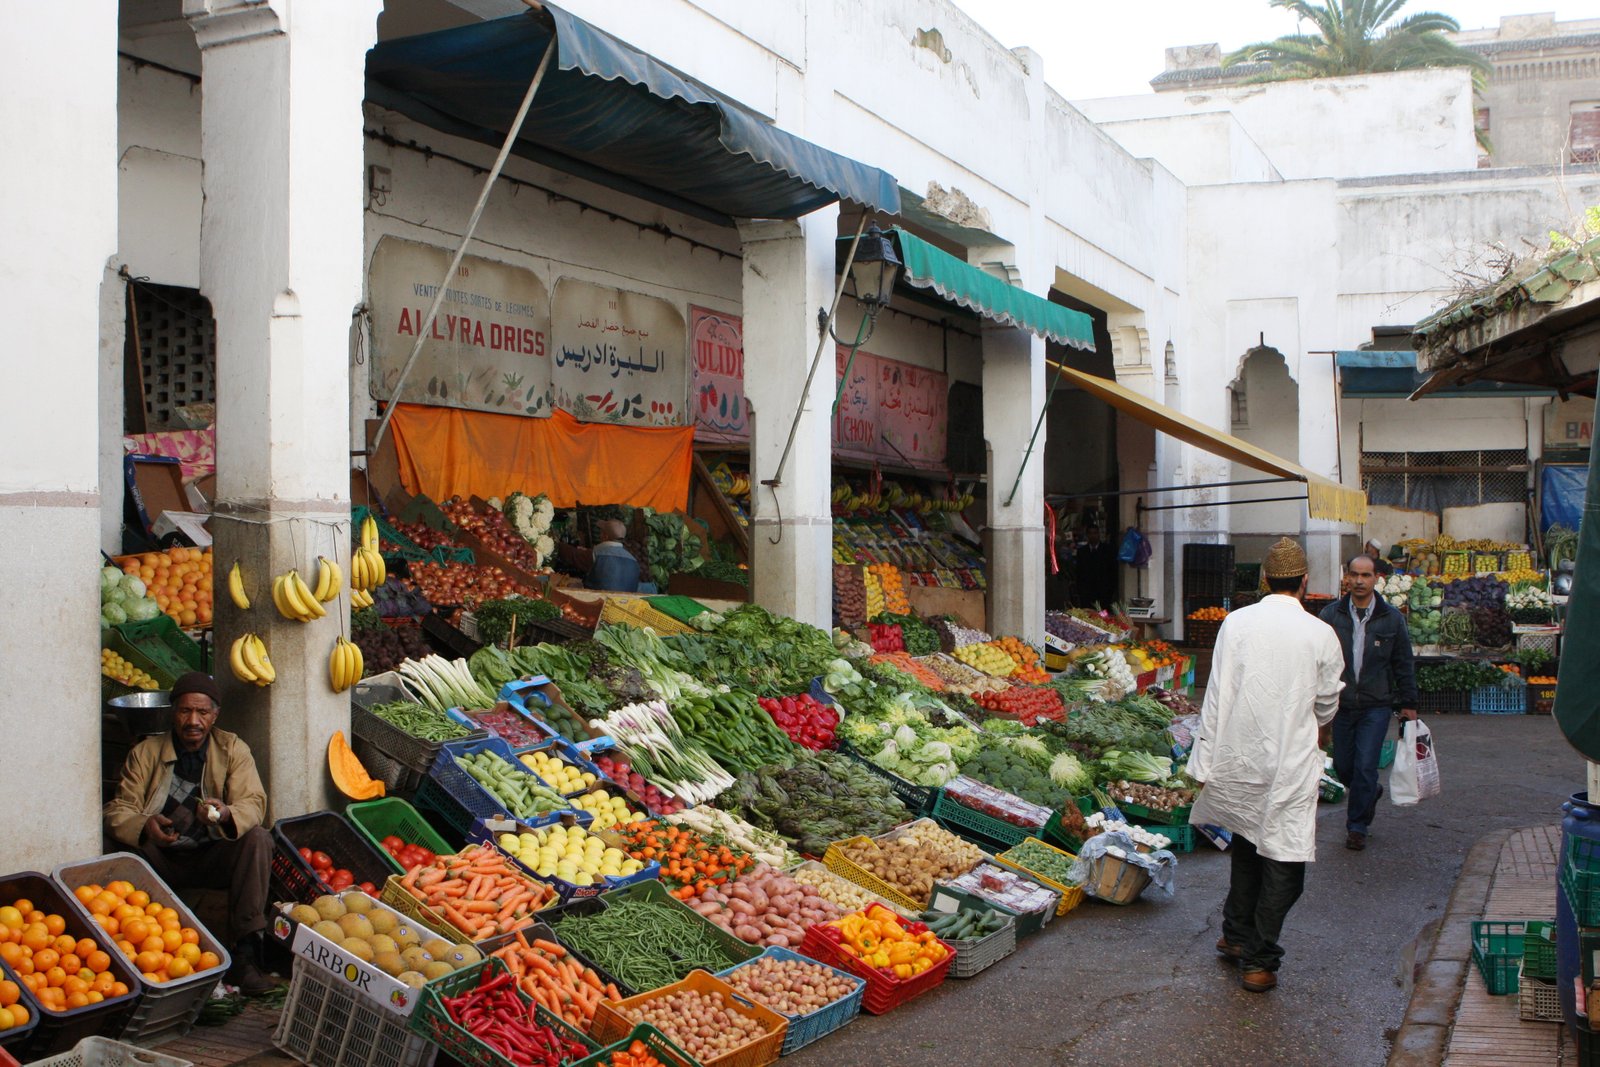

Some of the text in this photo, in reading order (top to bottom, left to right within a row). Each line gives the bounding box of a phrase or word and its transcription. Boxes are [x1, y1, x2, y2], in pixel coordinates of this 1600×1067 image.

[470, 293, 493, 310] SORTES
[494, 302, 502, 312] DE
[505, 303, 535, 317] LEGUMES
[490, 323, 545, 356] DRISS
[555, 343, 607, 373] ادريس
[843, 415, 874, 447] CHOIX
[302, 940, 371, 993] ARBOR
